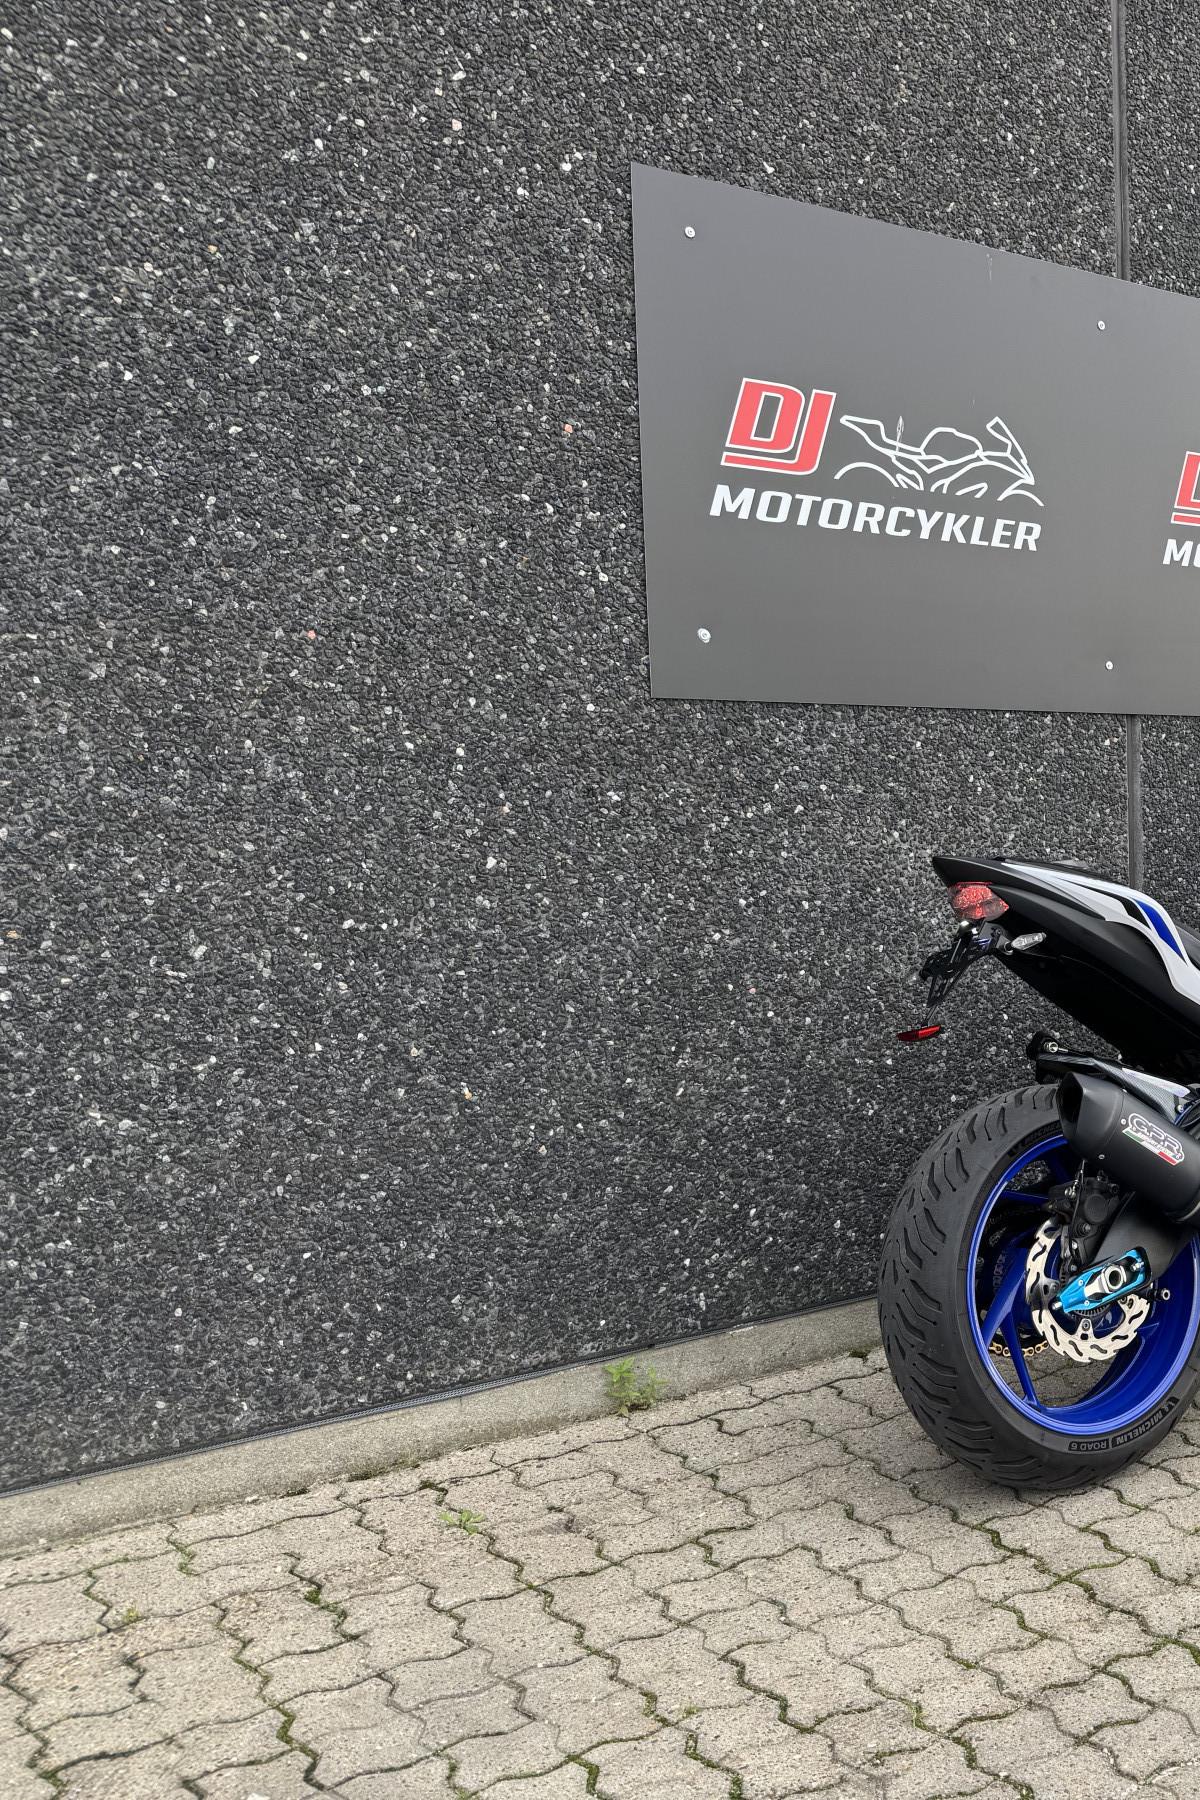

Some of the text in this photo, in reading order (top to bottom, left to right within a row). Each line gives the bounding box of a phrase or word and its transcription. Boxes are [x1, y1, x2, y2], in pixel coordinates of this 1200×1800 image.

[720, 377, 837, 477] DJ
[709, 483, 1043, 553] MOTORCYKLER
[1070, 1440, 1107, 1450] ROAD 6
[1115, 1411, 1163, 1445] MICHELIN
